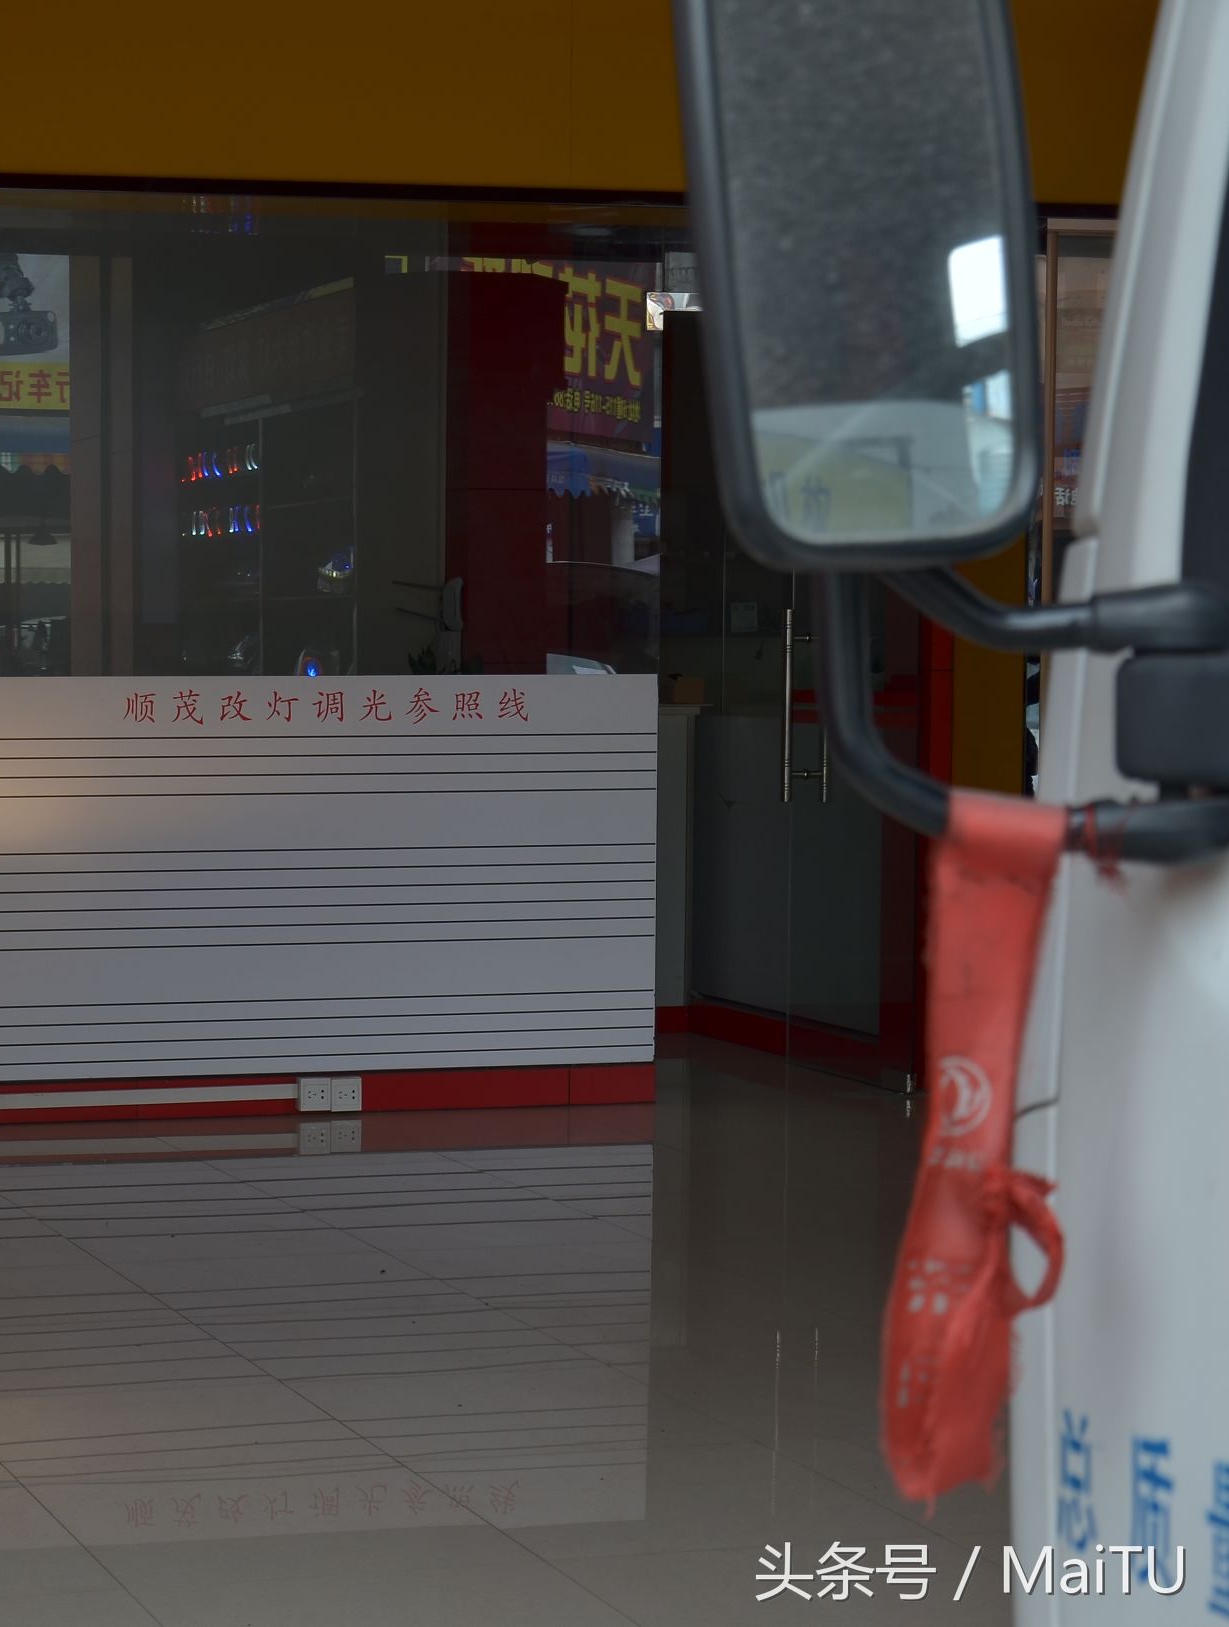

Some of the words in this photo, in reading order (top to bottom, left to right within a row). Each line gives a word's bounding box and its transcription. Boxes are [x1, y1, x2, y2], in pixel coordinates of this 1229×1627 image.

[123, 687, 530, 725] 顺茂改灯调光参照线
